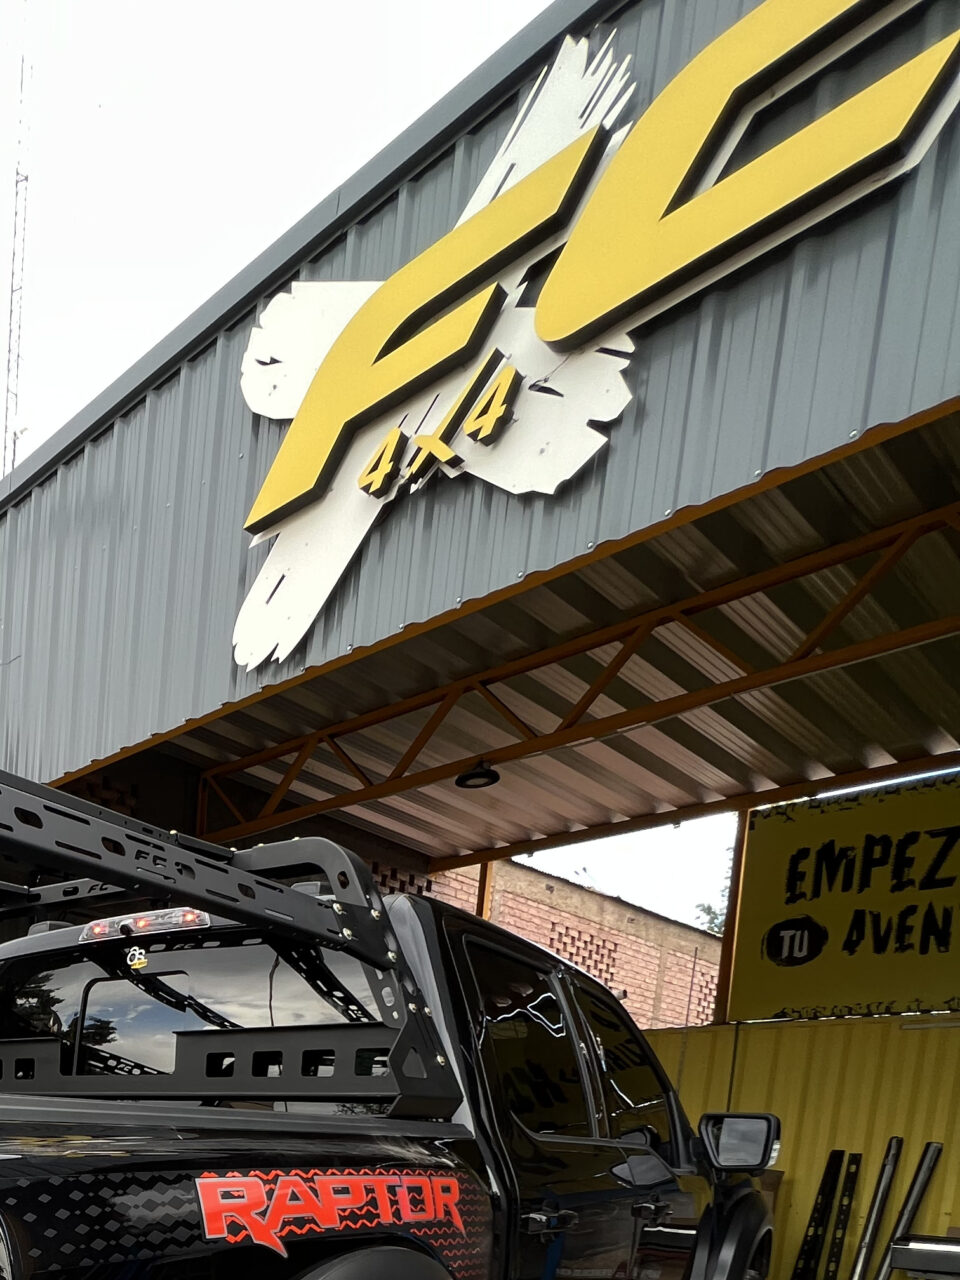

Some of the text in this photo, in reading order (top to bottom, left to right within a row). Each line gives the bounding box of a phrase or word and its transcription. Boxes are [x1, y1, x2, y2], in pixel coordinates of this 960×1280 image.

[134, 849, 168, 868] FC
[785, 825, 960, 905] EMPEZ
[87, 883, 109, 894] FC
[779, 901, 955, 959] TU AVEN
[195, 1174, 468, 1259] RAPTOR
